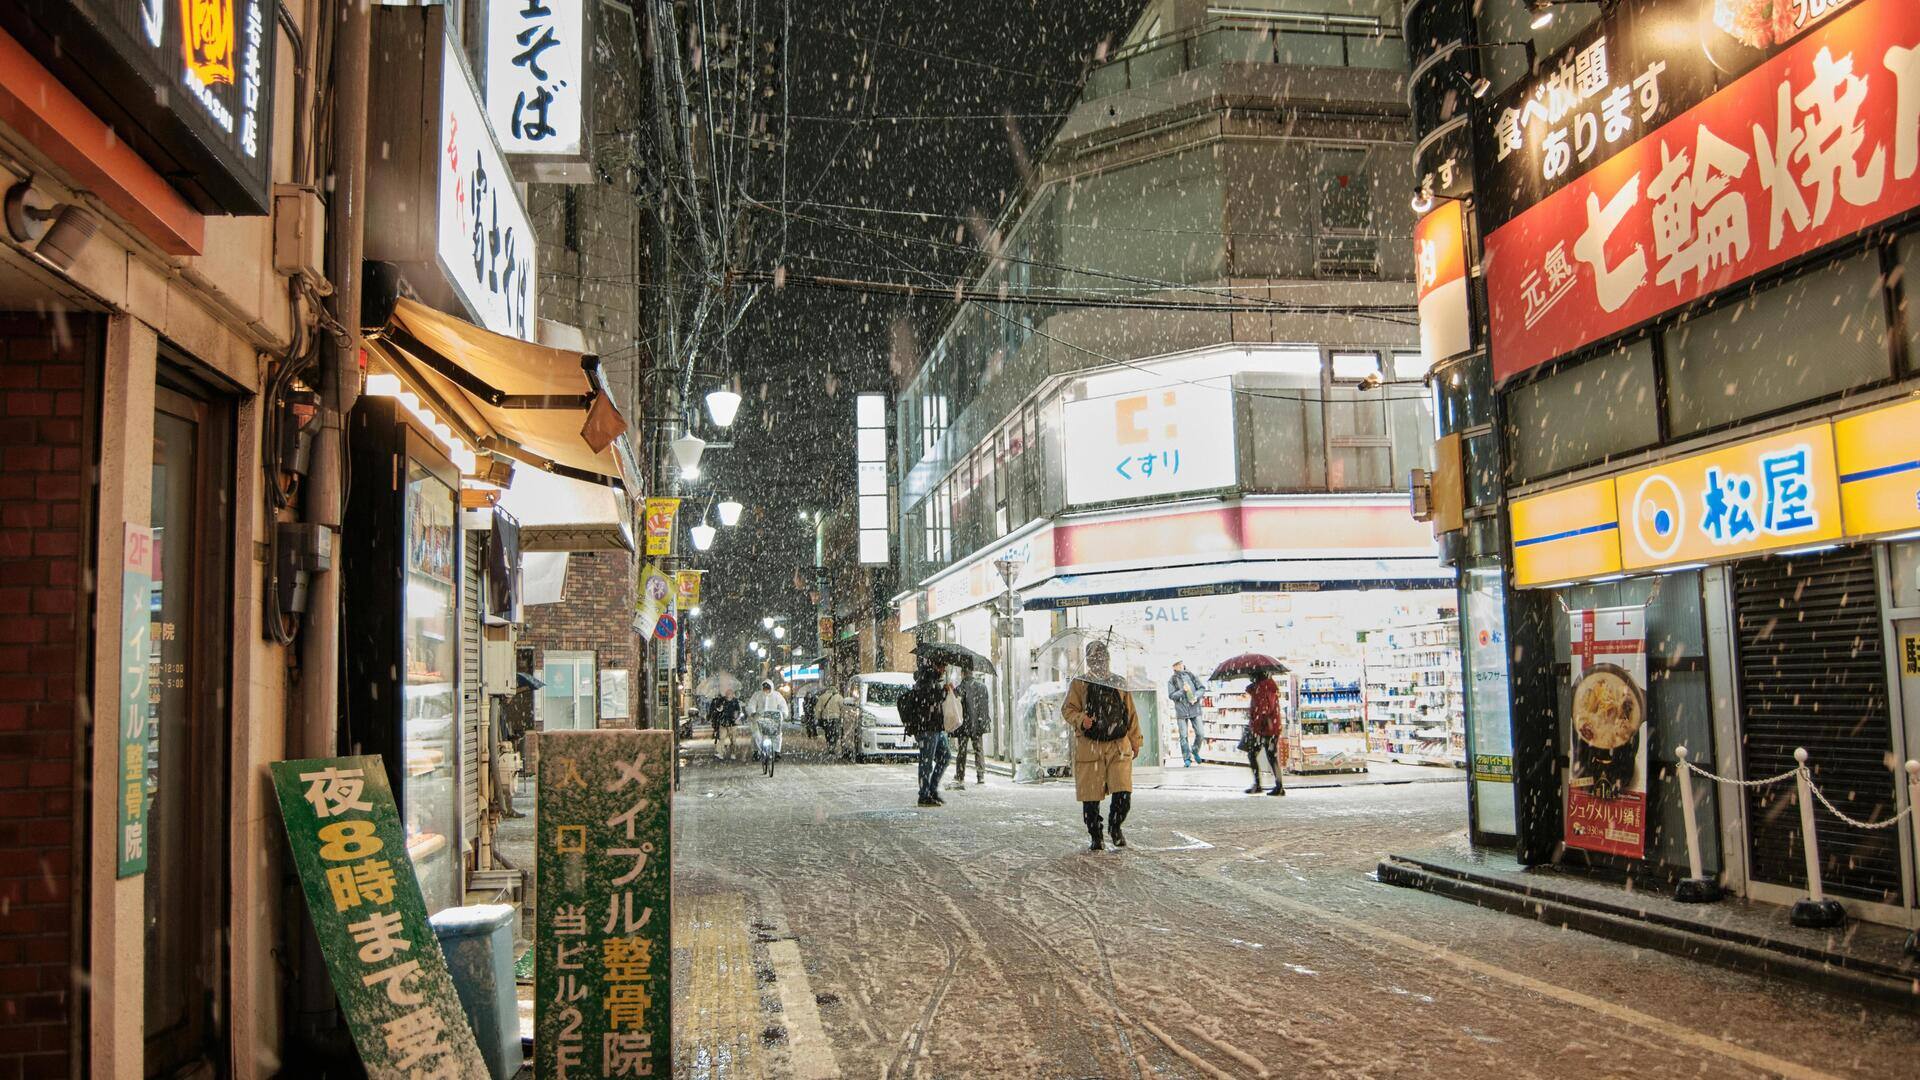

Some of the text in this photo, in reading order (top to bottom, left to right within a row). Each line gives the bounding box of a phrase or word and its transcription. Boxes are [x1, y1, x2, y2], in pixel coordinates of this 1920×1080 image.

[1496, 36, 1610, 163] 食べ放題
[1542, 60, 1667, 181] あります
[447, 110, 467, 236] 名代
[470, 148, 531, 343] 富士そば
[1116, 449, 1180, 480] くすり
[1702, 448, 1817, 541] 松屋
[127, 532, 150, 567] 2F
[1145, 606, 1189, 621] SALE
[124, 586, 146, 863] メイプル整骨院
[601, 752, 653, 1078] メイプル整骨院
[552, 904, 589, 1080] 当ビル2F
